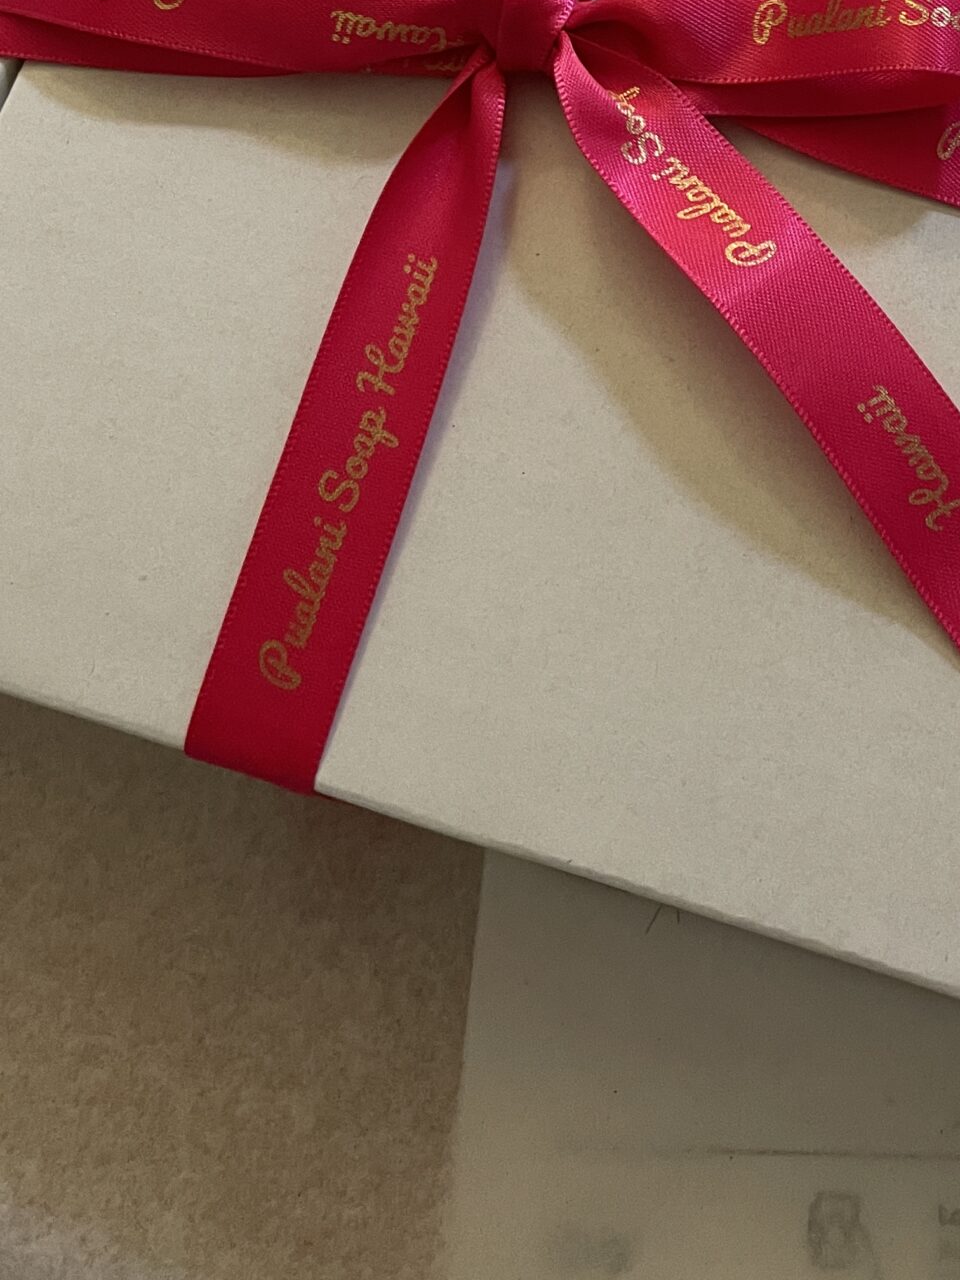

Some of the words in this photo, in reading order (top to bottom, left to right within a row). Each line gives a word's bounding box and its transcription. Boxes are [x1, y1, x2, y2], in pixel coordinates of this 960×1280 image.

[651, 156, 777, 266] Pualani
[356, 252, 438, 395] Hawaii
[317, 406, 399, 513] Soap
[258, 517, 347, 690] Pualani
